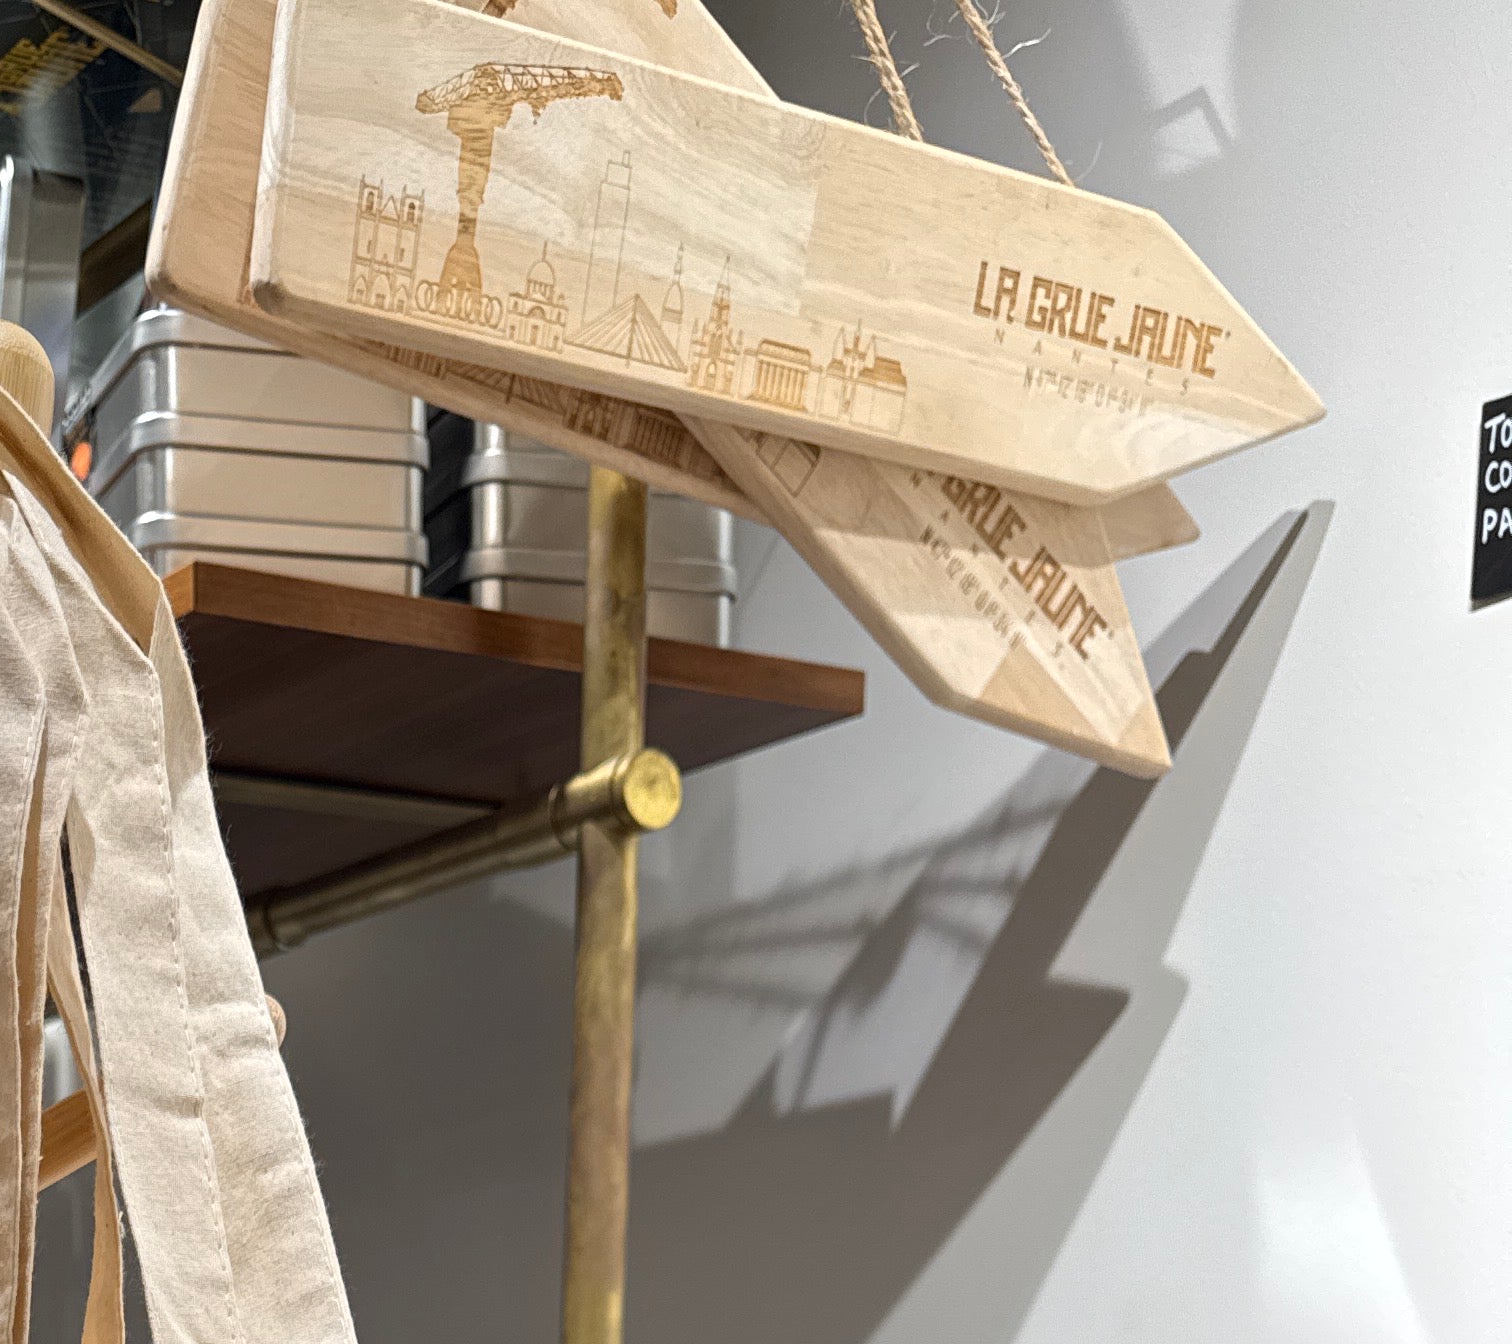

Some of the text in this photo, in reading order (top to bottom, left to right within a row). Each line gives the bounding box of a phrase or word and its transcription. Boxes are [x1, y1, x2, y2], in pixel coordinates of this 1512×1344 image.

[973, 260, 1224, 379] LA GRUE JAUNE
[1008, 545, 1108, 661] JAUNE
